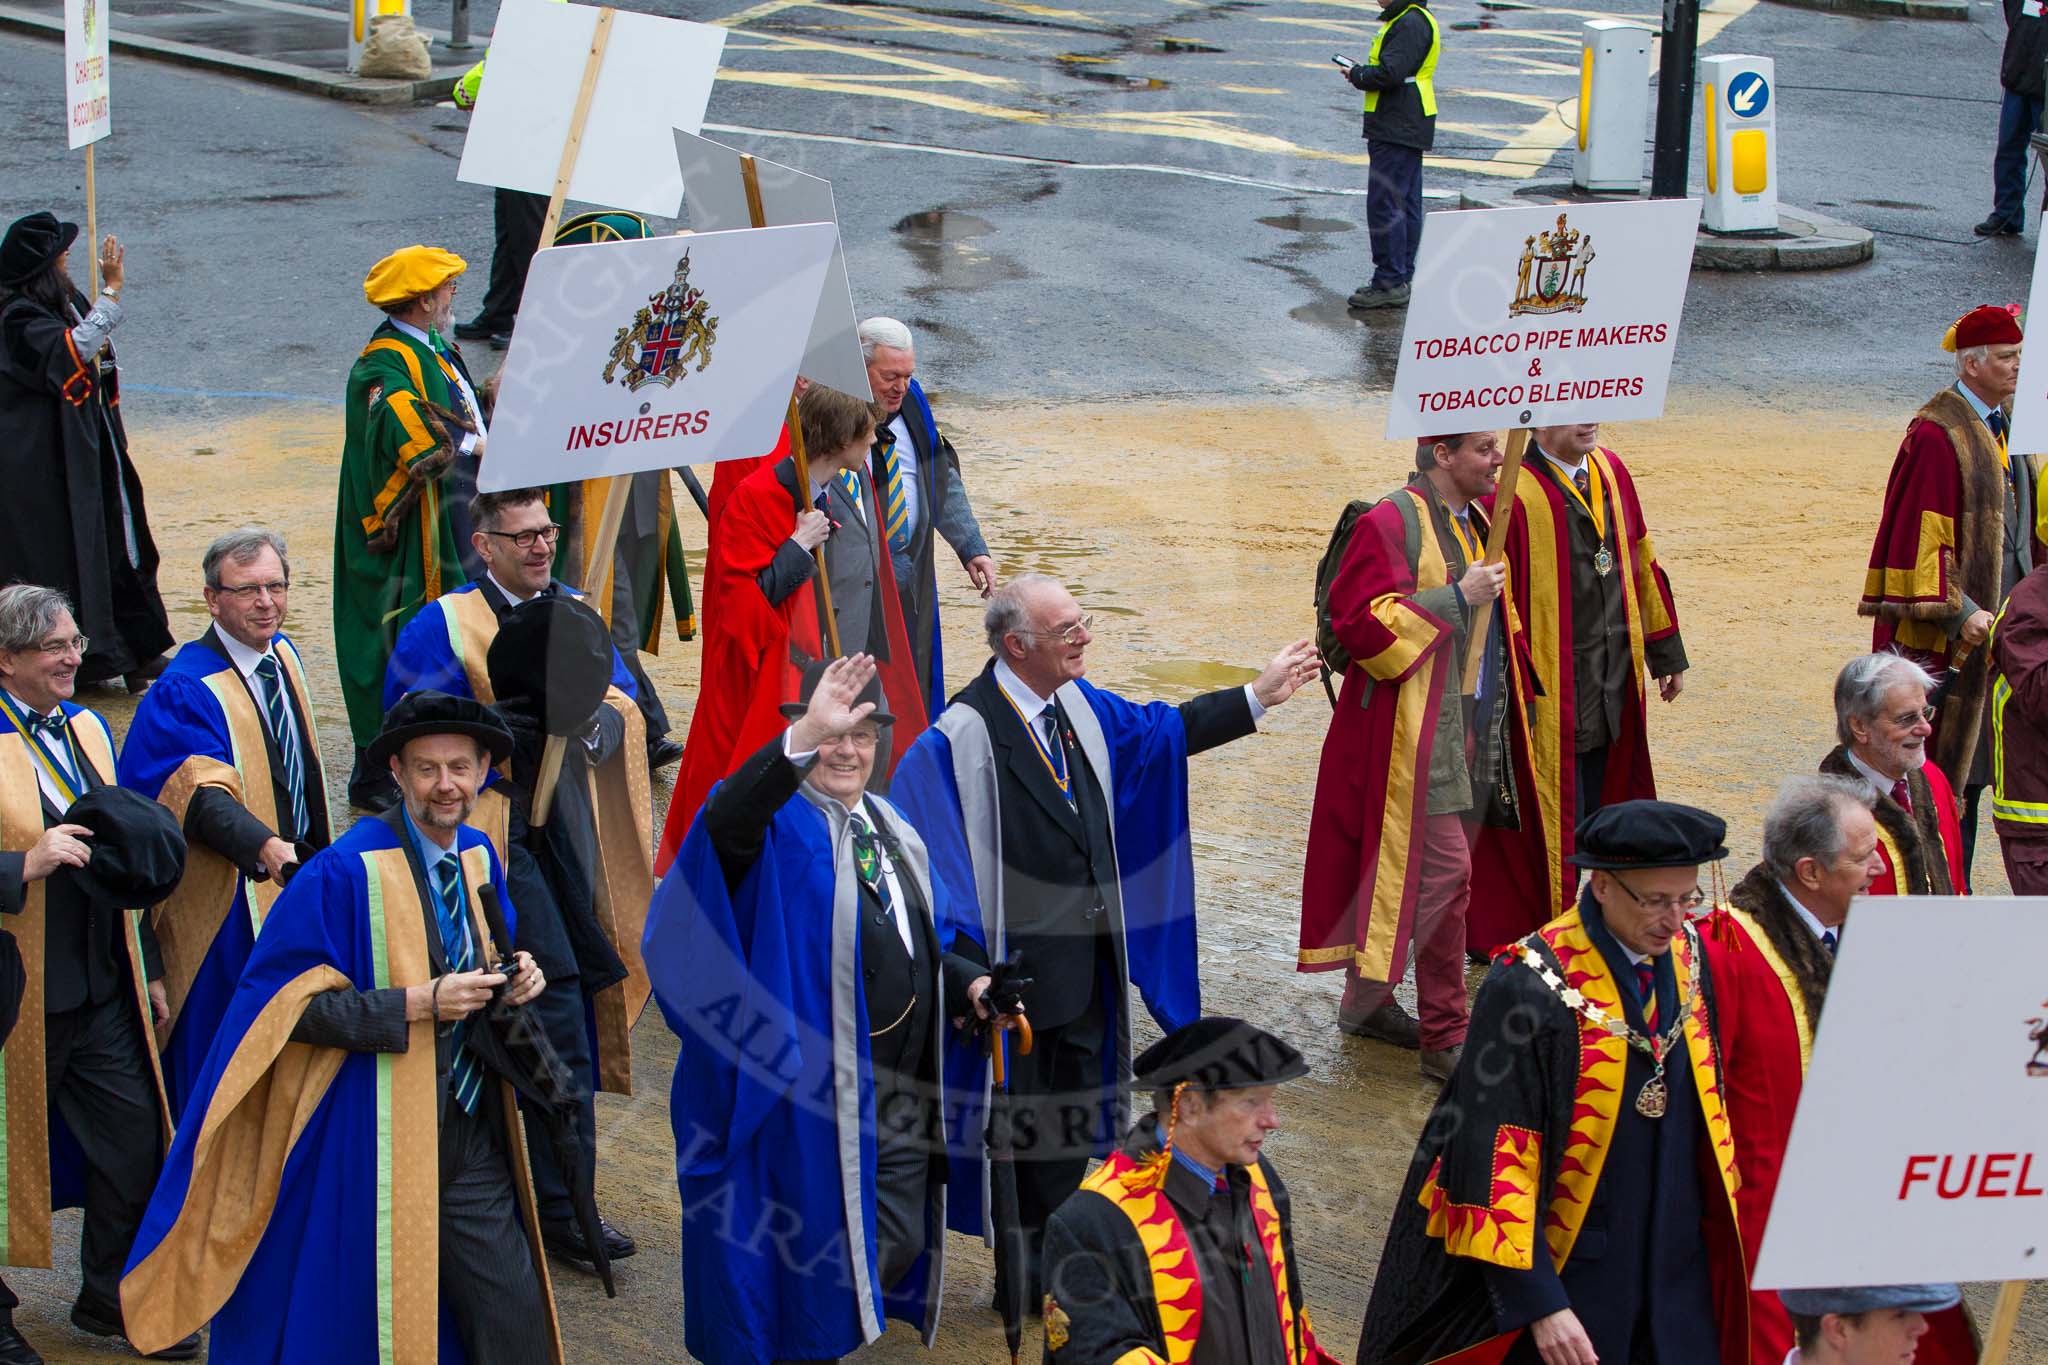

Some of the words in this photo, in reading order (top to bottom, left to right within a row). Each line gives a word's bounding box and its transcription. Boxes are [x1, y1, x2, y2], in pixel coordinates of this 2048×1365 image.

[1413, 332, 1521, 360] TOBACCO
[1524, 328, 1574, 351] PIPE
[1576, 323, 1668, 348] MAKERS
[1527, 357, 1543, 378] &
[1417, 384, 1524, 413] TOBACCO
[1528, 376, 1645, 404] BLENDERS
[565, 409, 711, 452] INSURERS
